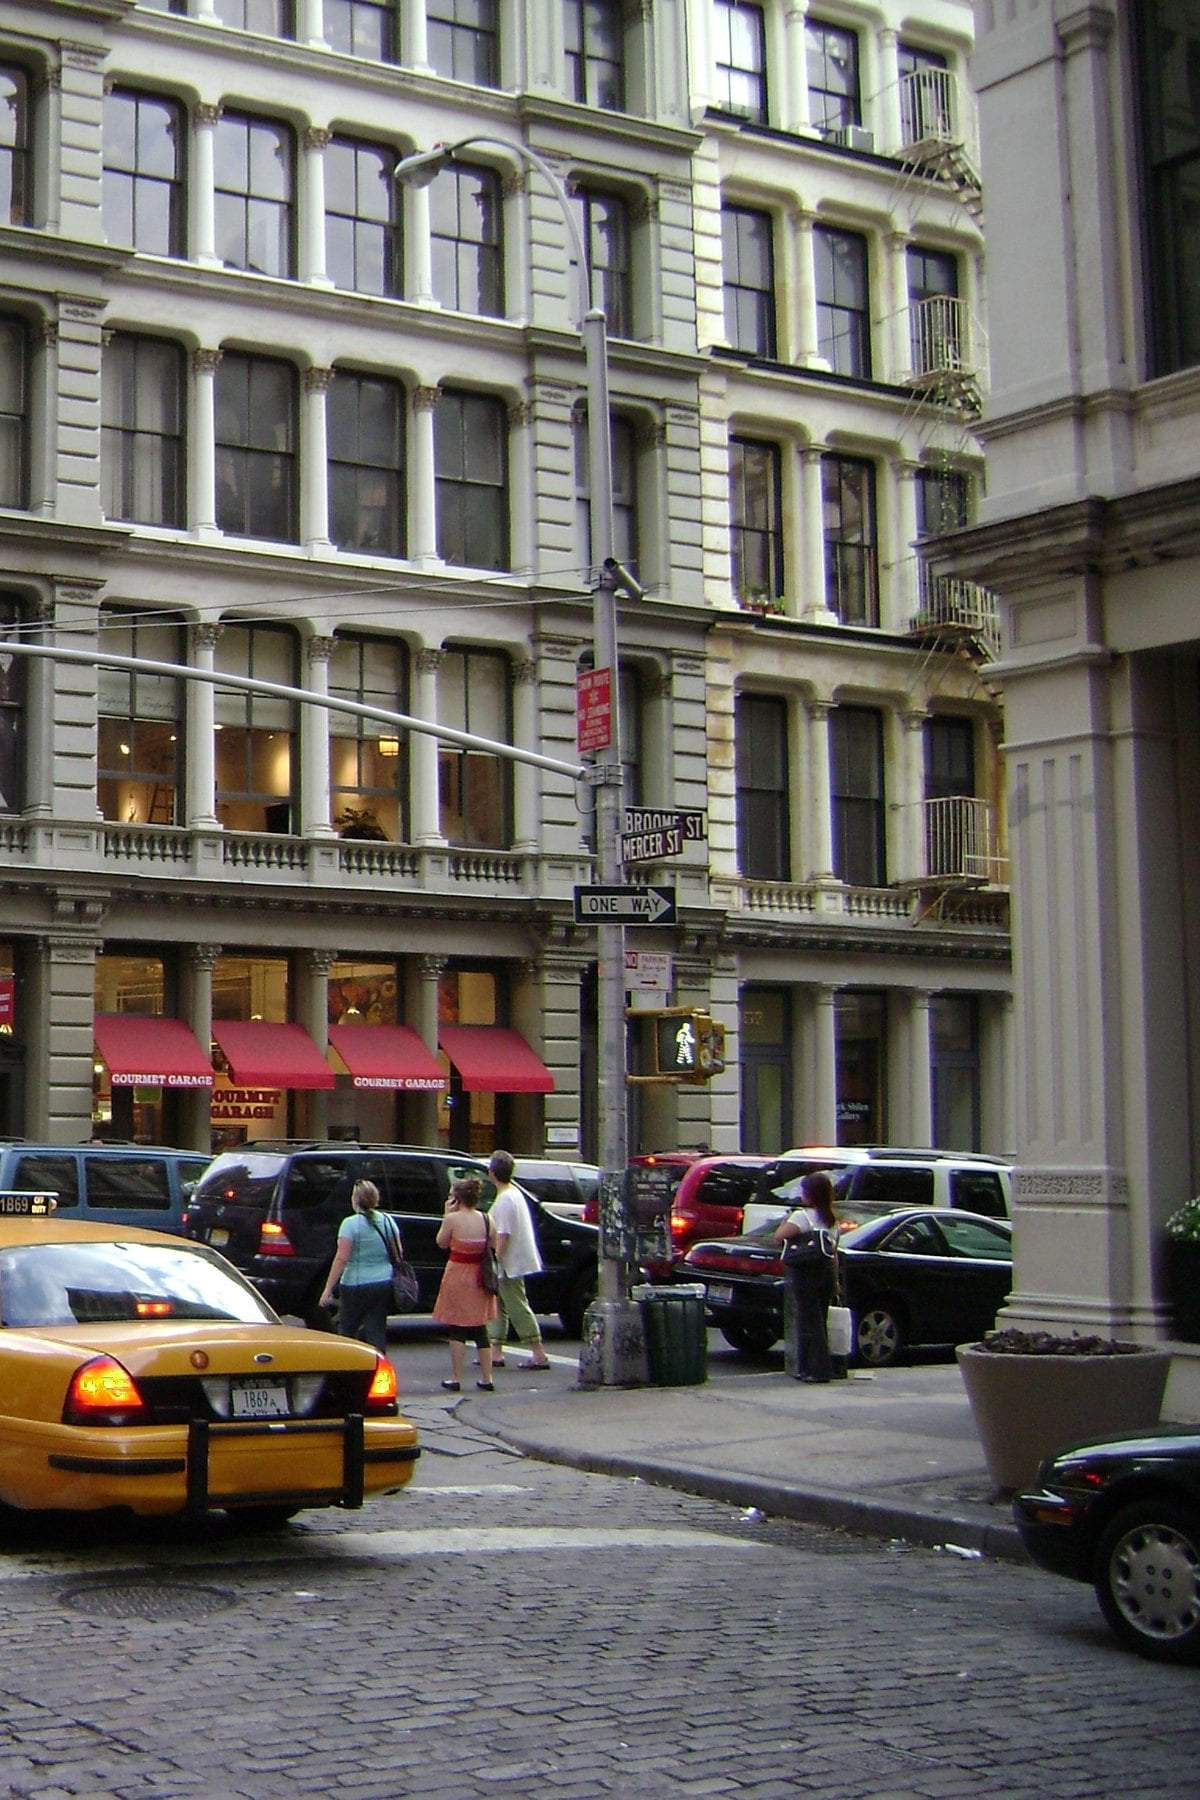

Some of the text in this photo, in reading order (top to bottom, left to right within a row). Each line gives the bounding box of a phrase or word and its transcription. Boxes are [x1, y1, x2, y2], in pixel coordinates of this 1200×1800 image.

[686, 816, 702, 838] ST
[623, 830, 680, 861] MERCER ST
[589, 897, 660, 913] ONE WAY
[625, 952, 637, 968] NO
[112, 1074, 213, 1086] GOURMET GARAGE
[354, 1076, 446, 1089] GOURMET GARAGE
[31, 1205, 46, 1214] DUTY
